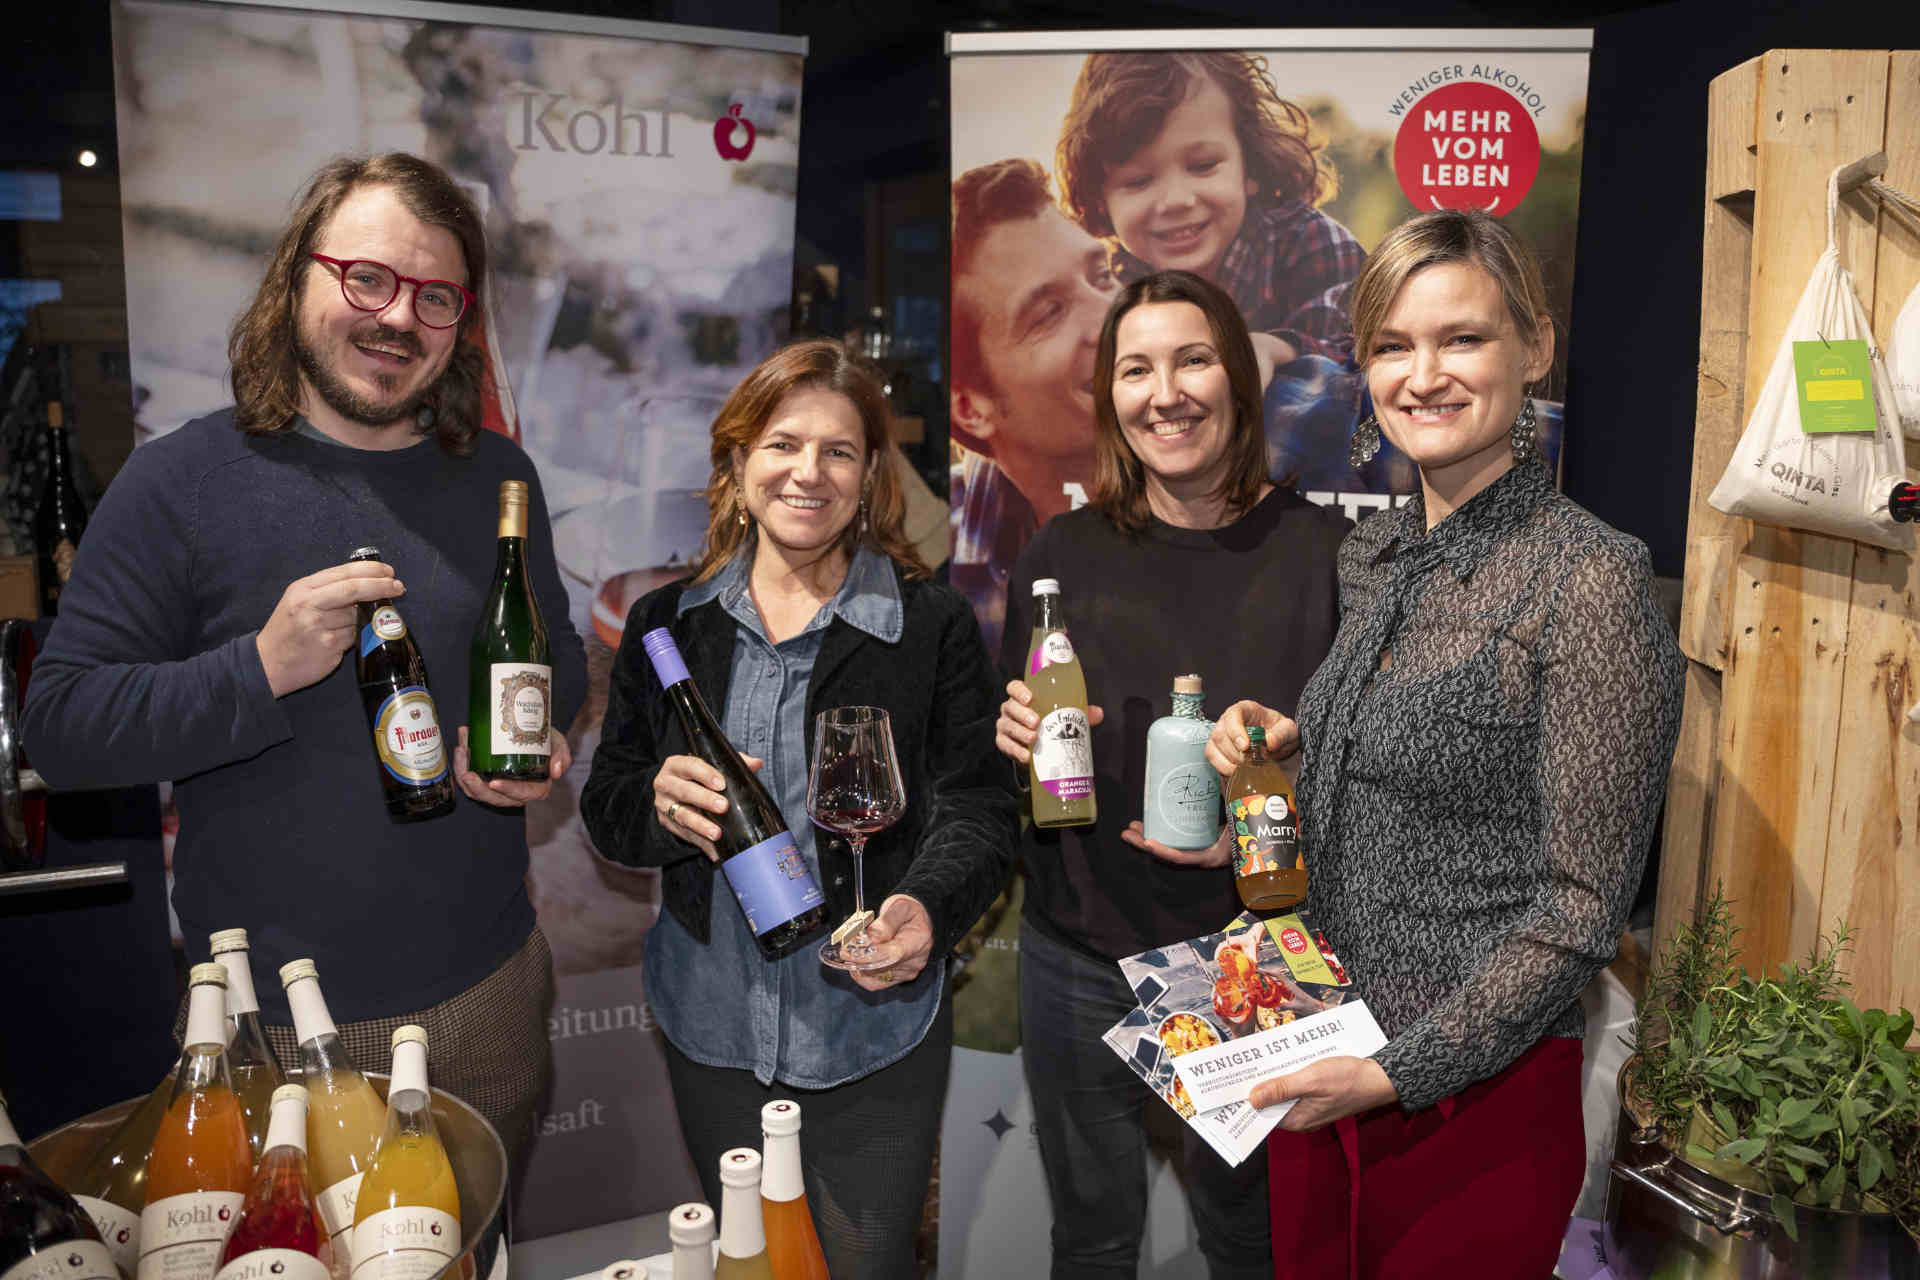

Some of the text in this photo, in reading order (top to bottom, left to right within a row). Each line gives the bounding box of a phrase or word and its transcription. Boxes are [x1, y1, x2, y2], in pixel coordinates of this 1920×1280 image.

[1388, 64, 1546, 118] WENIGER ALKOHOL
[514, 92, 675, 158] Kohl
[1423, 110, 1512, 132] MEHR
[1432, 137, 1504, 160] VOM
[1422, 164, 1509, 187] LEBEN
[1771, 462, 1825, 494] QINTA
[1256, 823, 1297, 841] Marry
[1189, 1047, 1263, 1077] WENIGER
[1265, 1038, 1291, 1055] IST
[1294, 1019, 1345, 1046] MEHR!
[168, 1205, 212, 1228] Kohl
[382, 1218, 424, 1235] Kohl
